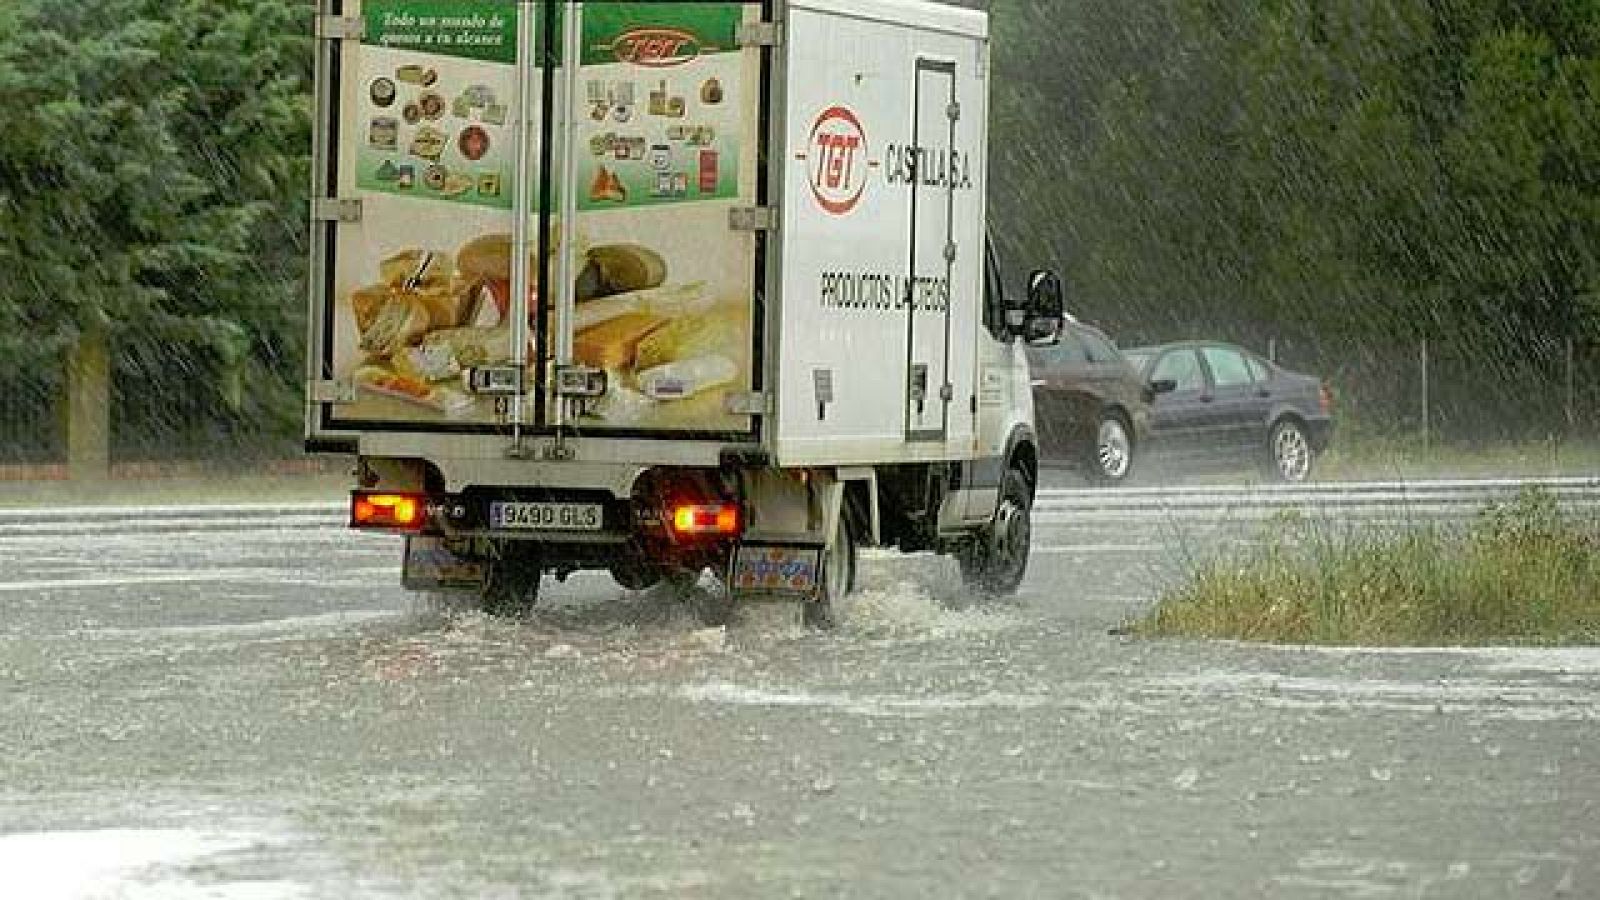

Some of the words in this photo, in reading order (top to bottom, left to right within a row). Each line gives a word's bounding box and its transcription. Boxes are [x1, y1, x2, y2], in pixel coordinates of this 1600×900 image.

[384, 12, 415, 26] Todo
[419, 17, 436, 26] un
[441, 12, 486, 28] mundo
[489, 13, 504, 28] de
[456, 31, 503, 46] alcance
[816, 133, 860, 191] TGT
[820, 271, 892, 311] PRODUCTOS
